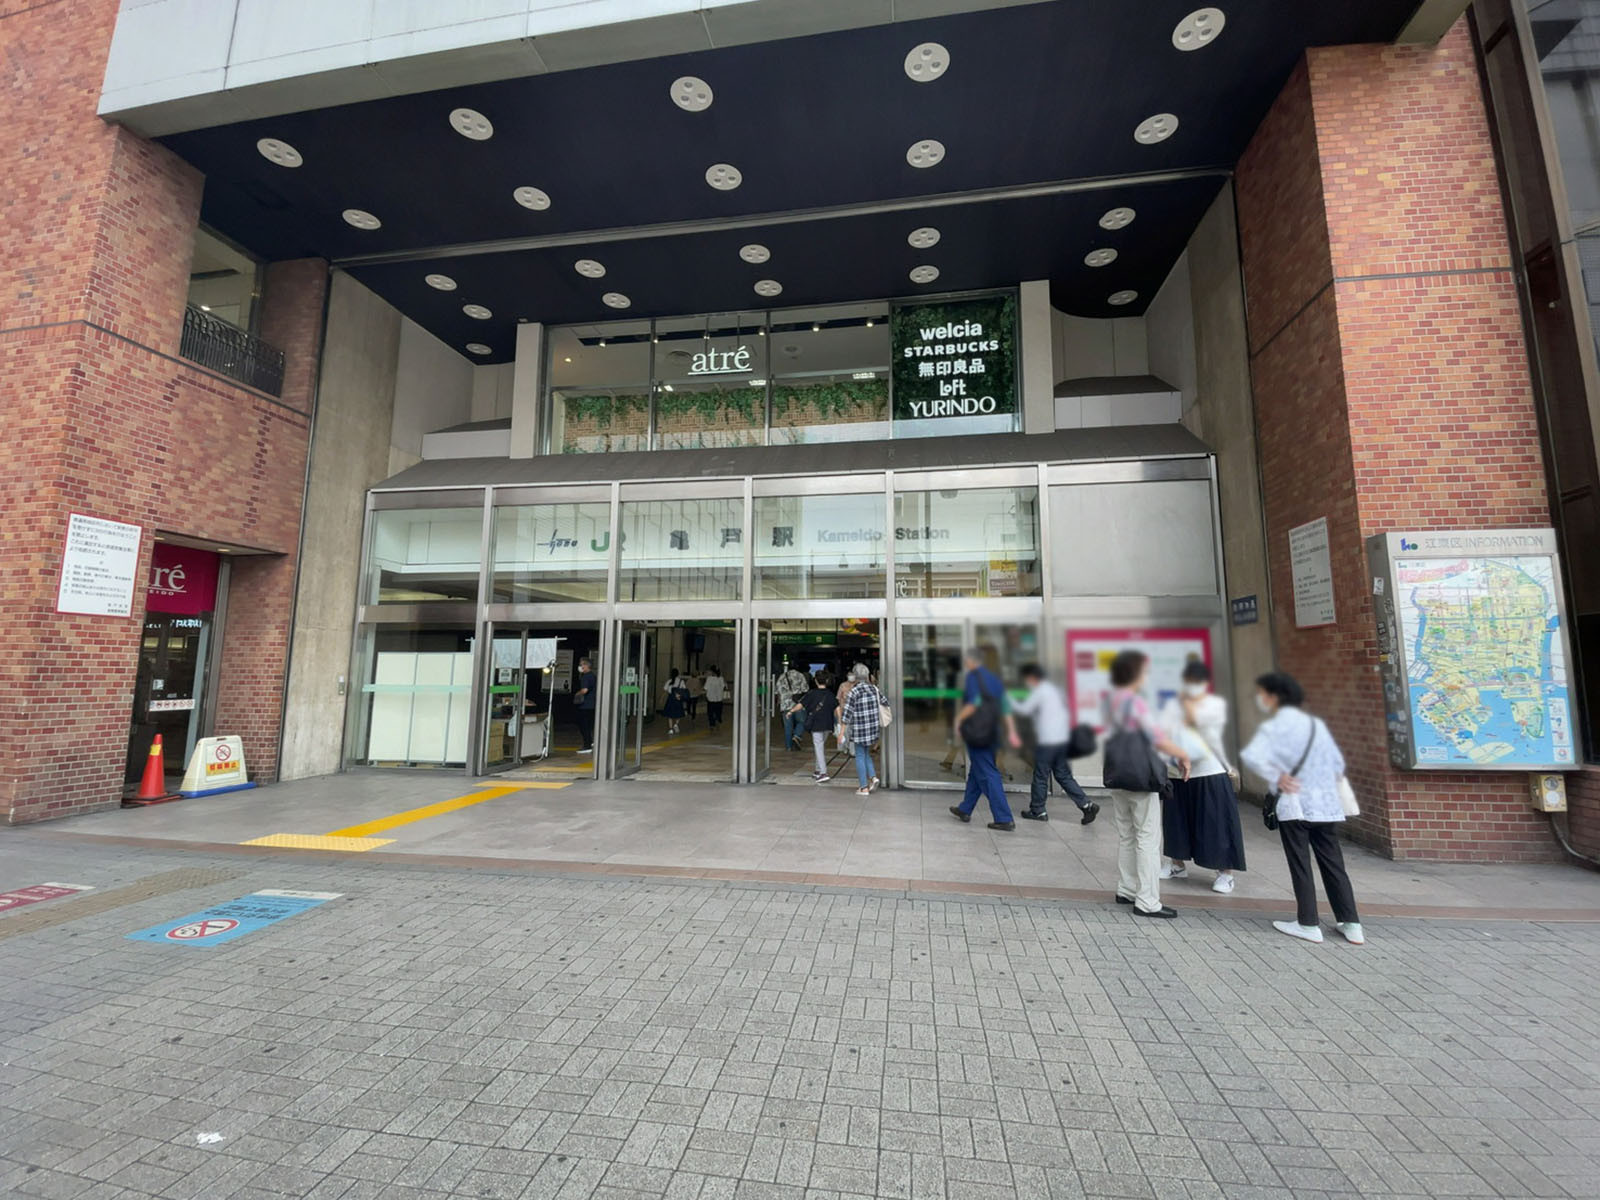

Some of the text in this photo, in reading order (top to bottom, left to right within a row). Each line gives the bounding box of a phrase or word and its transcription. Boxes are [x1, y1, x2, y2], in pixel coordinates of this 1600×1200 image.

[919, 319, 983, 341] welcia
[690, 345, 751, 372] atré
[903, 340, 1000, 358] STARBUCKS
[918, 358, 986, 378] 無印良品
[908, 395, 997, 418] YURINDO
[817, 526, 950, 543] Kameido Station
[1465, 535, 1544, 549] INFORMATION
[150, 564, 186, 590] ré
